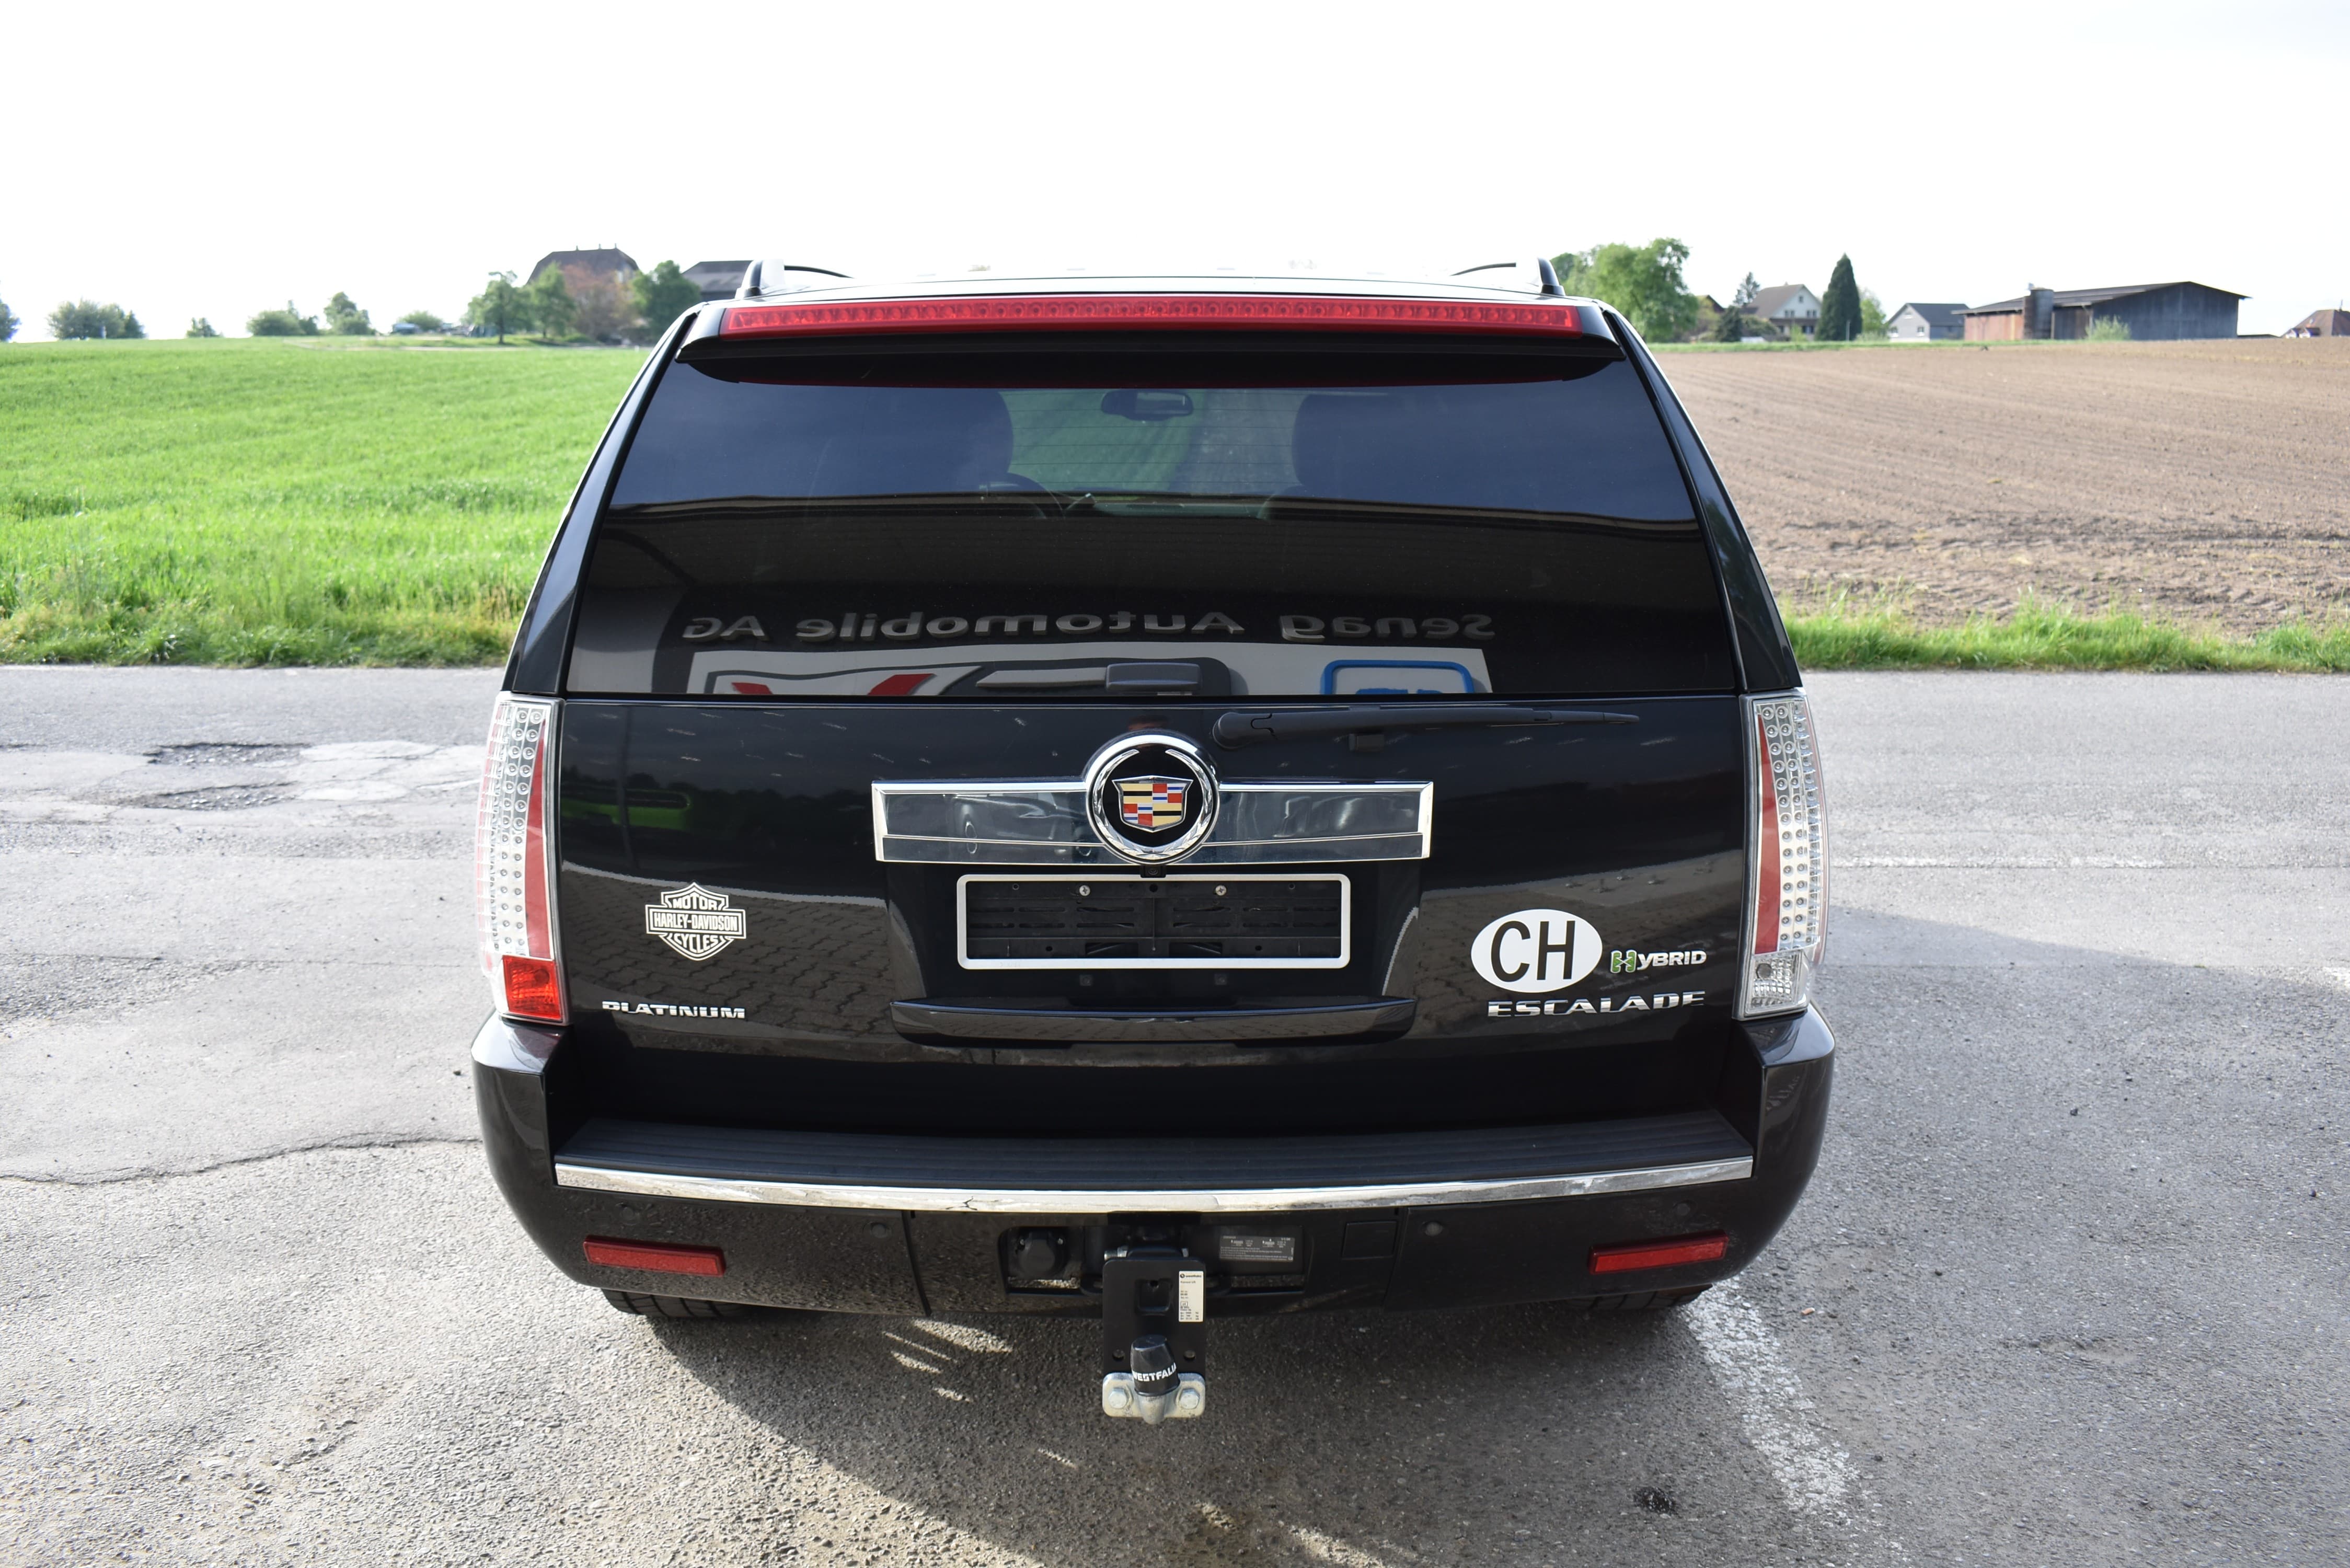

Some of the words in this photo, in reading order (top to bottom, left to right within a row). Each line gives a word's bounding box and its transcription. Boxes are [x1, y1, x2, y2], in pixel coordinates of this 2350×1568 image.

[673, 894, 717, 909] MOTOR
[653, 912, 738, 931] HARLEY-DAVIDSON
[674, 934, 718, 953] CYCLES
[1491, 920, 1576, 983] CH
[602, 1001, 745, 1019] PLATINUM
[1488, 990, 1706, 1017] ESCALADE
